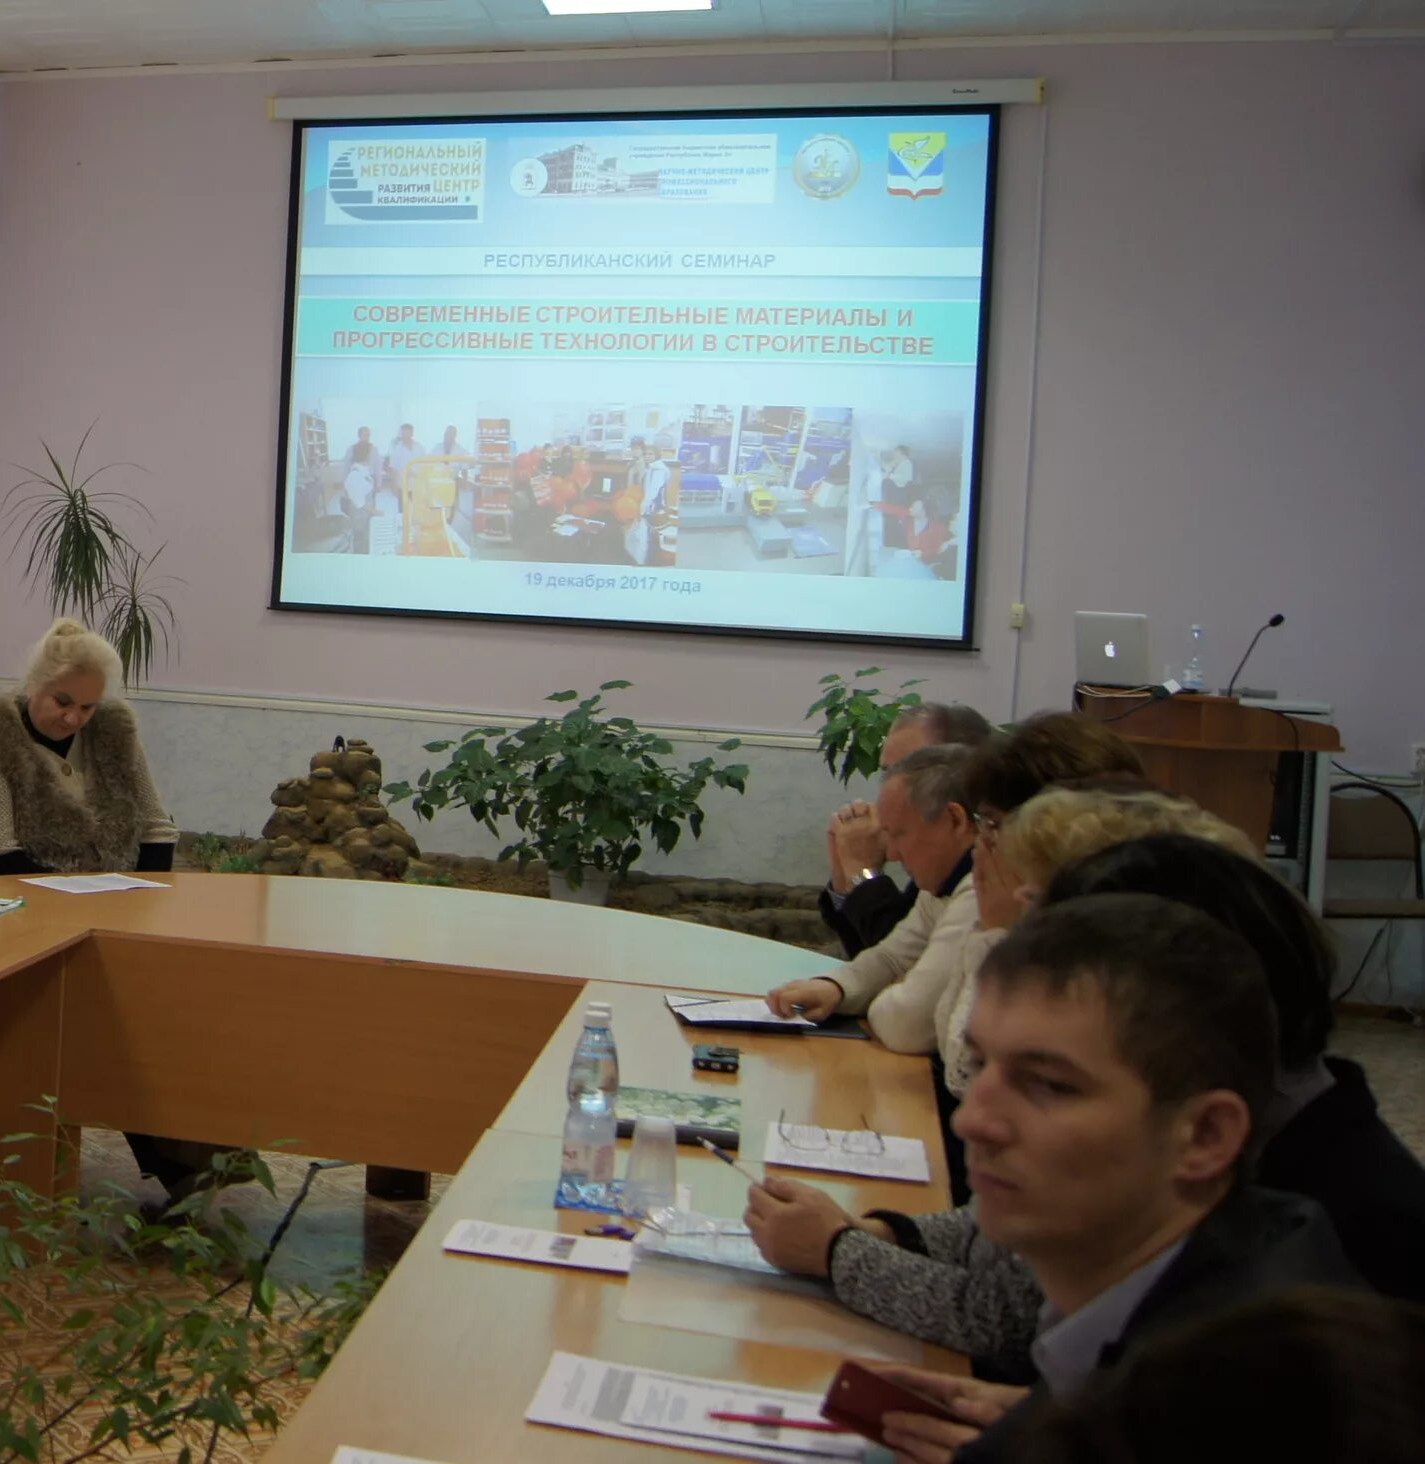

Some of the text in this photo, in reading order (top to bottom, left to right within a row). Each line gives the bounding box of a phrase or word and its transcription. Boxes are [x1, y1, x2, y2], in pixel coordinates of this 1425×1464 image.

[357, 141, 482, 160] РЕГИОНАЛЬНЫЙ
[361, 160, 481, 177] МЕТОДИЧЕСКИЙ
[378, 183, 431, 193] РАЗВИТИЯ
[433, 179, 480, 193] ЦЕНТР
[377, 195, 459, 204] КВАЛИФИКАЦИИ
[483, 251, 776, 269] РЕСПУБЛИКАНСКИЙ СЕМИНАР
[353, 305, 913, 326] СОВРЕМЕННЫЕ СТРОИТЕЛЬНЫЕ МАТЕРИАЛЫ И
[333, 331, 934, 355] ПРОГРЕССИВНЫЕ ТЕХНОЛОГИИ В СТРОИТЕЛЬСТВЕ
[525, 572, 702, 595] 19 декабря 2017 года
